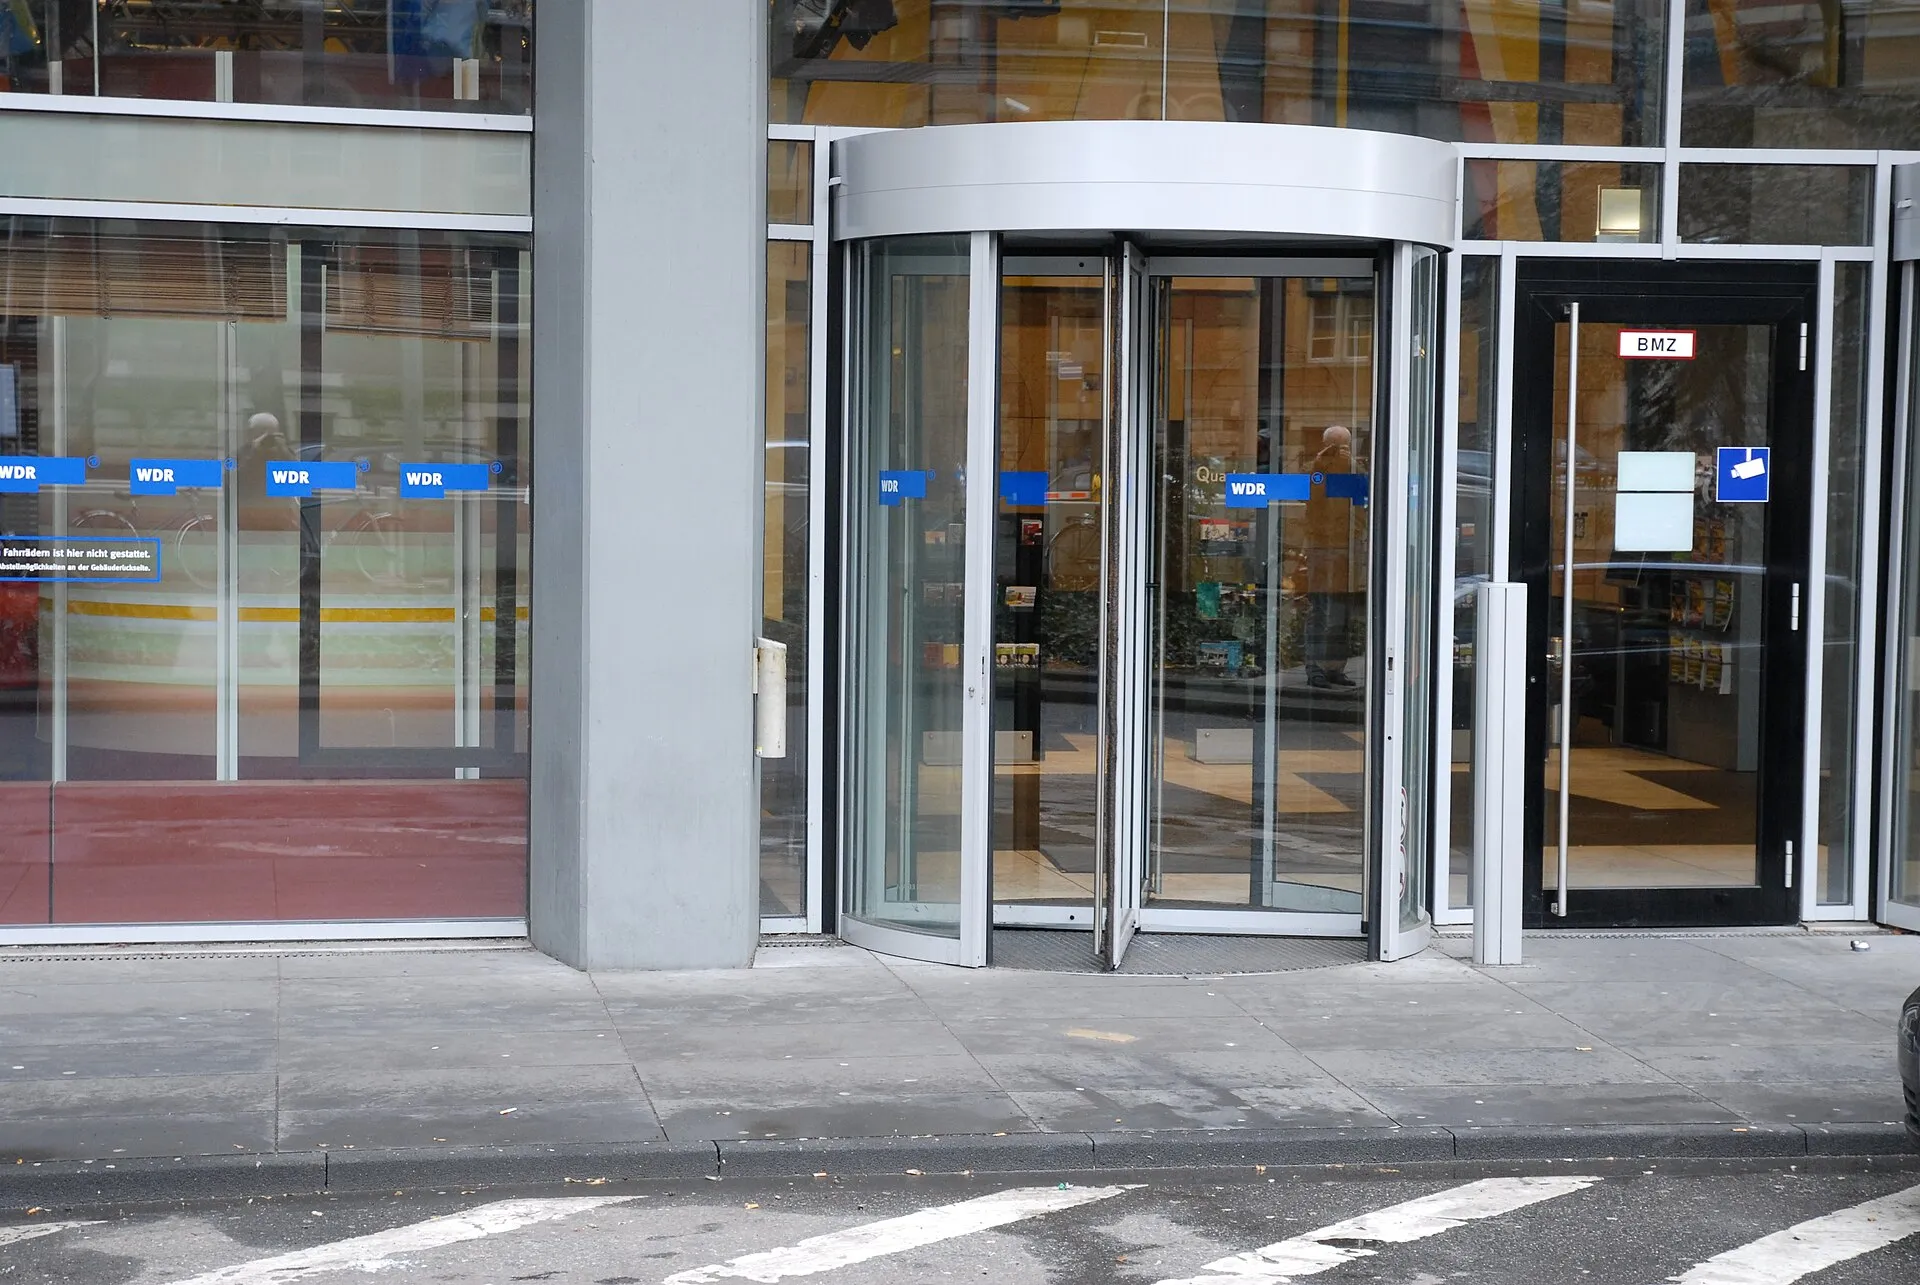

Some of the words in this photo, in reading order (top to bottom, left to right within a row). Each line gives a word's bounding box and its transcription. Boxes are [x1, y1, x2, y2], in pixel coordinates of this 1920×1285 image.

[1637, 337, 1677, 352] BMZ
[0, 465, 37, 480] WDR
[136, 468, 175, 482] WDR
[272, 470, 310, 484] WDR
[406, 472, 443, 486] WDR
[881, 479, 899, 493] WDR
[1231, 482, 1266, 496] WDR
[3, 547, 51, 558] Fahrrädern
[52, 548, 65, 558] ist
[66, 548, 85, 558] hier
[86, 548, 109, 558] nicht
[110, 549, 151, 560] gestattet.
[77, 563, 90, 571] der
